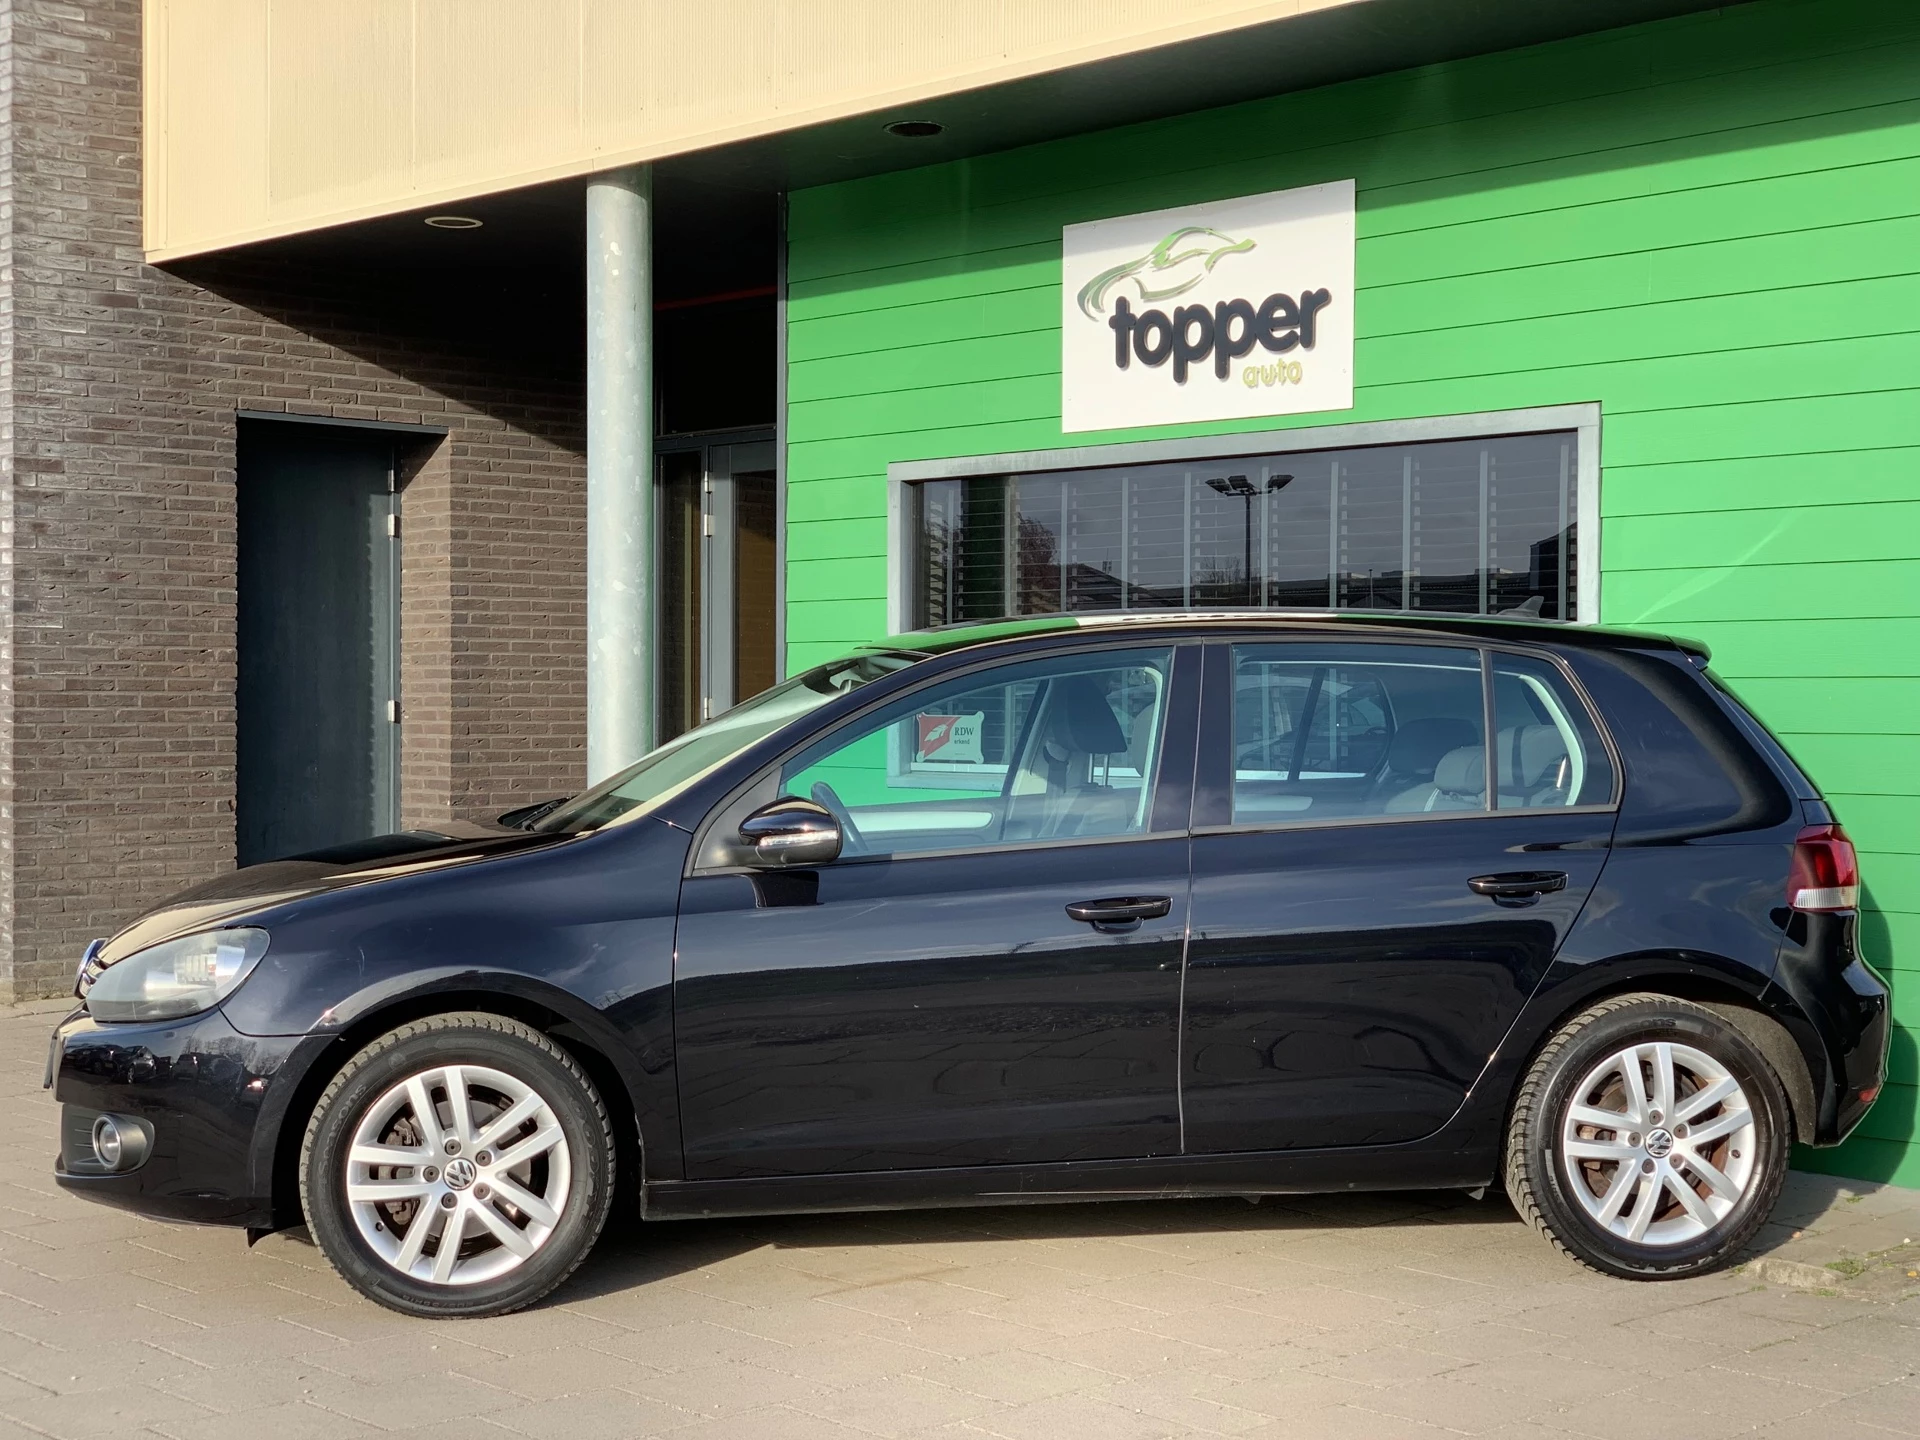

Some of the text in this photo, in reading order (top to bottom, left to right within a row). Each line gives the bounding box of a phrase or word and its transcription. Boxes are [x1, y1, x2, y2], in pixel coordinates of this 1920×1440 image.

[1109, 288, 1332, 384] topper
[1242, 357, 1303, 388] auto
[954, 726, 975, 736] RDW
